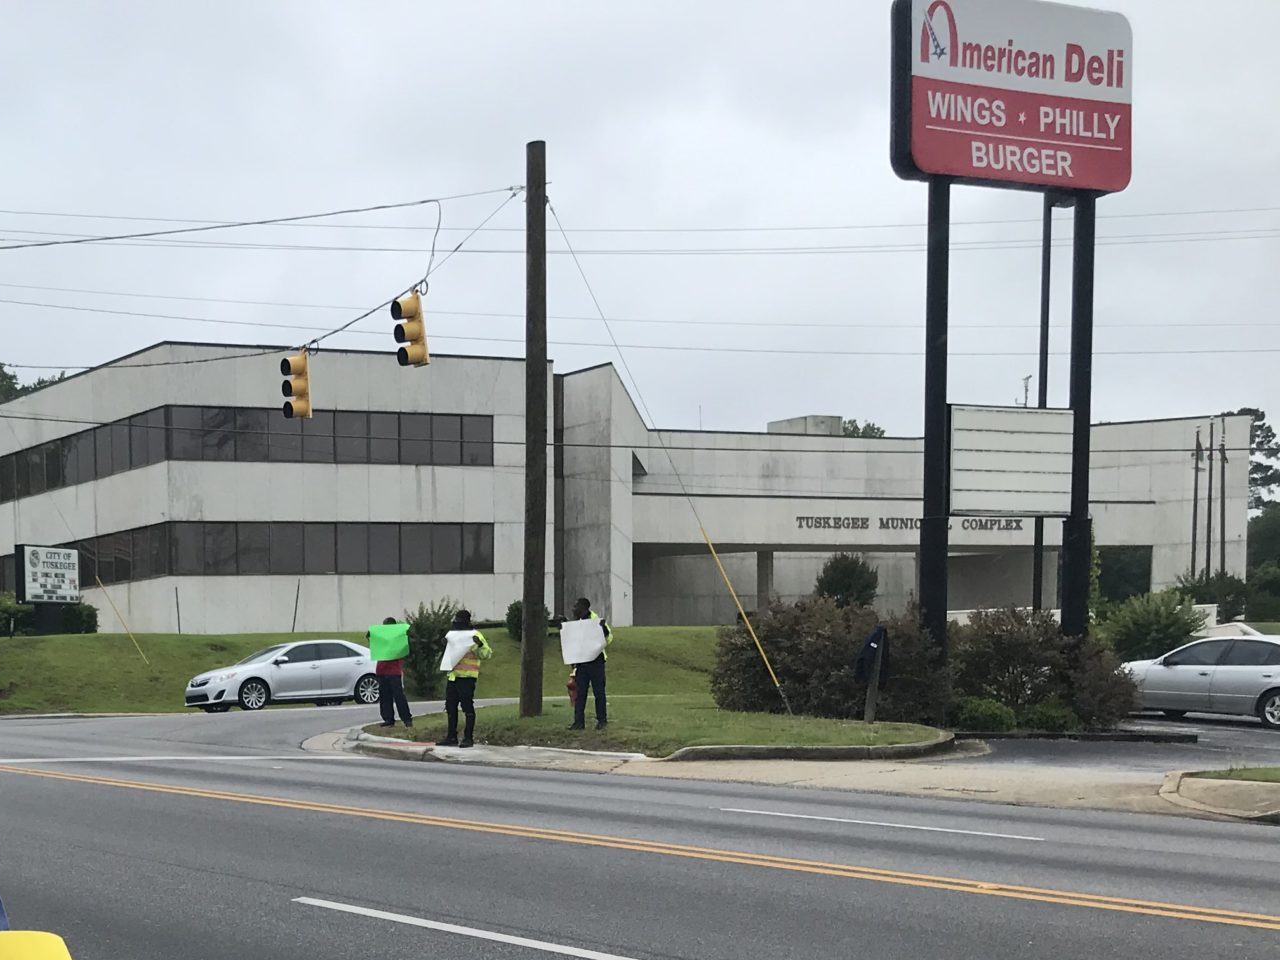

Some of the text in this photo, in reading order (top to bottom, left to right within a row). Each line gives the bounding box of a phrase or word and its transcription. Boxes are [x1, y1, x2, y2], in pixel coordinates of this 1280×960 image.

[920, 0, 1124, 89] American Deli
[927, 91, 1121, 140] WINGS PHILLY
[971, 141, 1073, 178] BURGER
[796, 516, 1023, 531] TUSKEGEE MUNICL COMPLEX
[41, 561, 76, 571] TUSKEGEE
[45, 551, 72, 561] CITY OF
